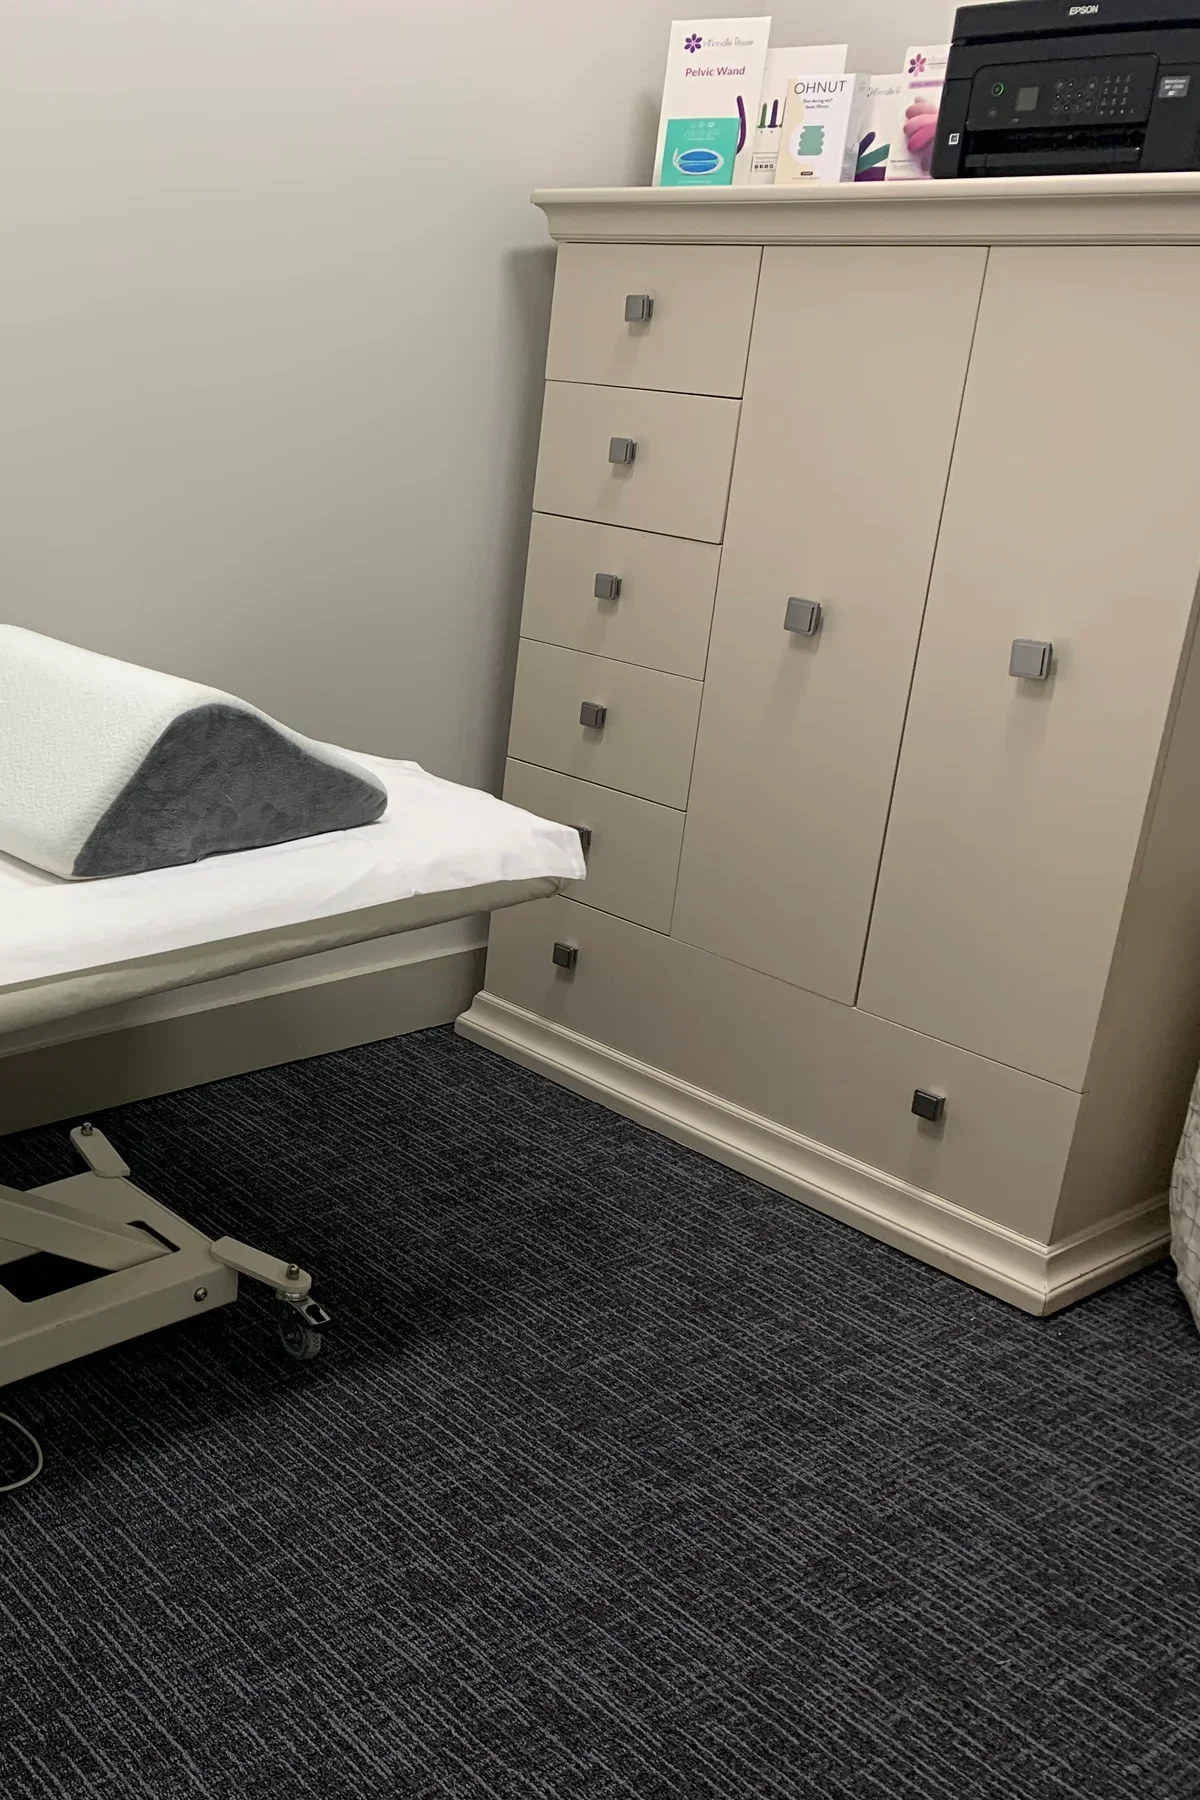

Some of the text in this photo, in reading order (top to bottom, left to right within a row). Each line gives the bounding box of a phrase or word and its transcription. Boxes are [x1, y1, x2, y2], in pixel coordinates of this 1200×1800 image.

[1069, 5, 1099, 16] EPSON
[686, 66, 746, 76] Pelvic Wand
[794, 80, 846, 94] OHNUT
